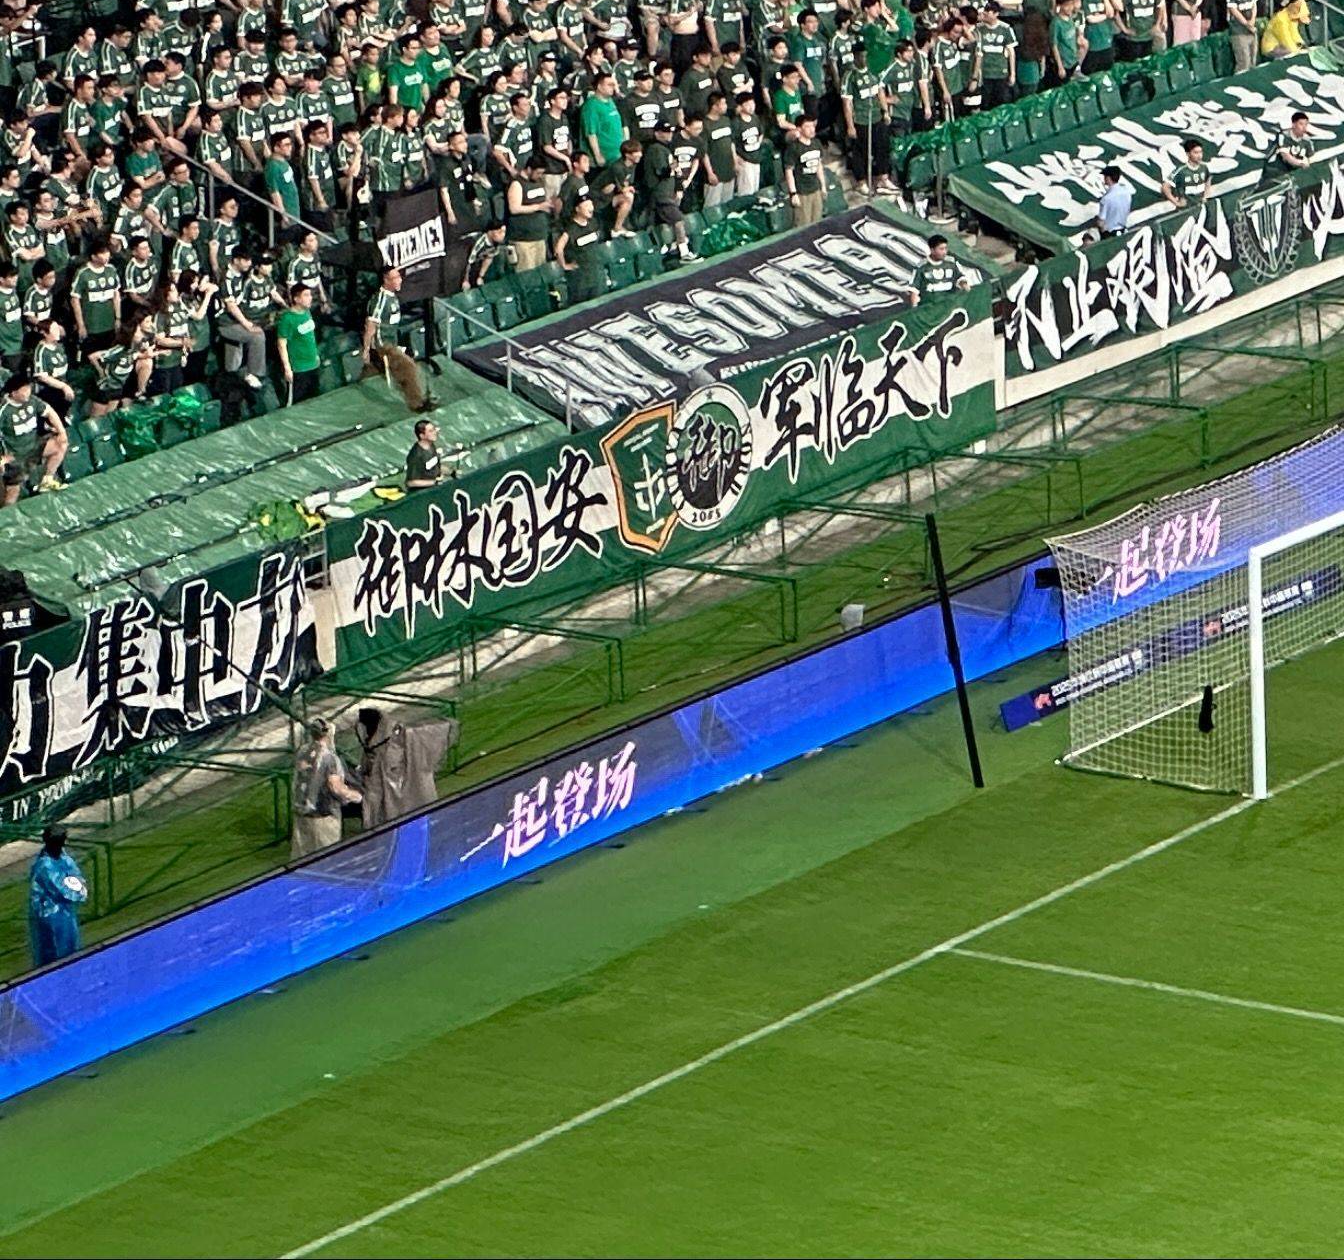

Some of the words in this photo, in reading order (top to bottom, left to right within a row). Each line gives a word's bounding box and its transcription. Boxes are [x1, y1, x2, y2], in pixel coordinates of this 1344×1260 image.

[353, 445, 608, 639] 御林国安
[1080, 498, 1222, 605] 一起登场
[460, 741, 637, 869] 一起登场
